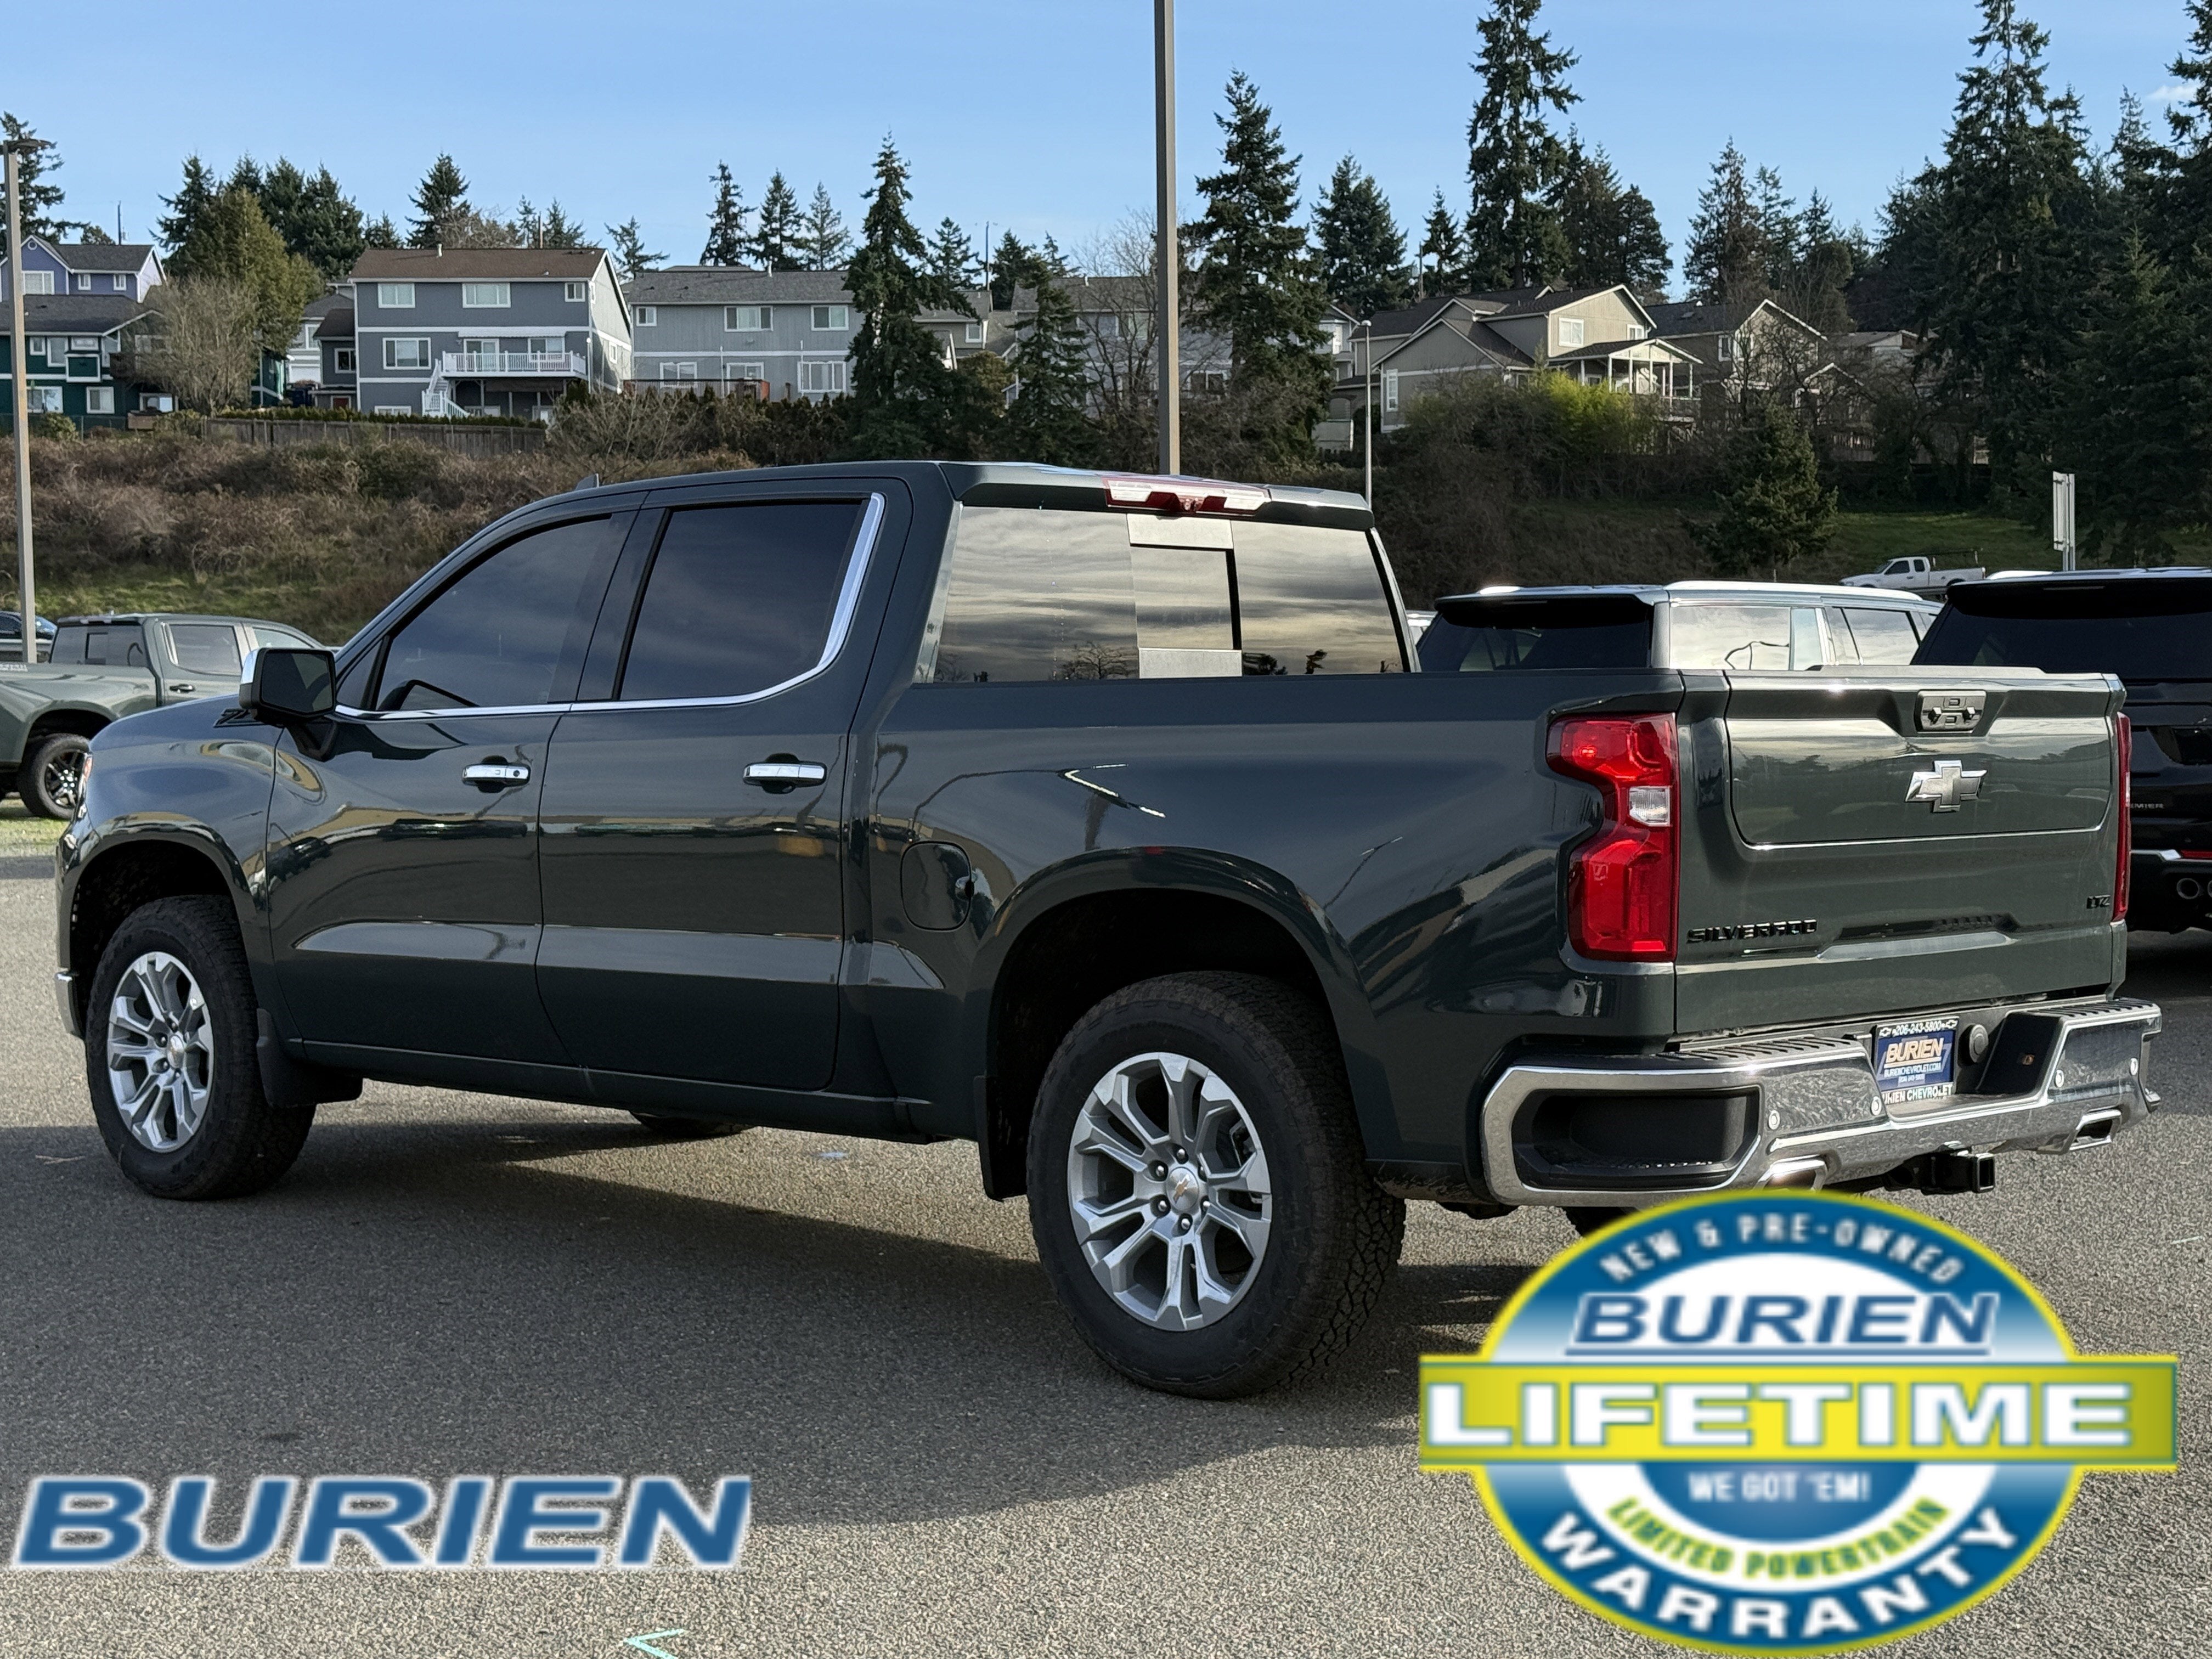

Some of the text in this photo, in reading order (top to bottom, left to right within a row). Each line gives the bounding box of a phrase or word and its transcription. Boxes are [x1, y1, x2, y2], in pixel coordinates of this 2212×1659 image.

[1686, 919, 1817, 944] SILVERADO
[1886, 1038, 1944, 1062] BURIEN
[1882, 1084, 1953, 1104] URIEN CHEVROLET
